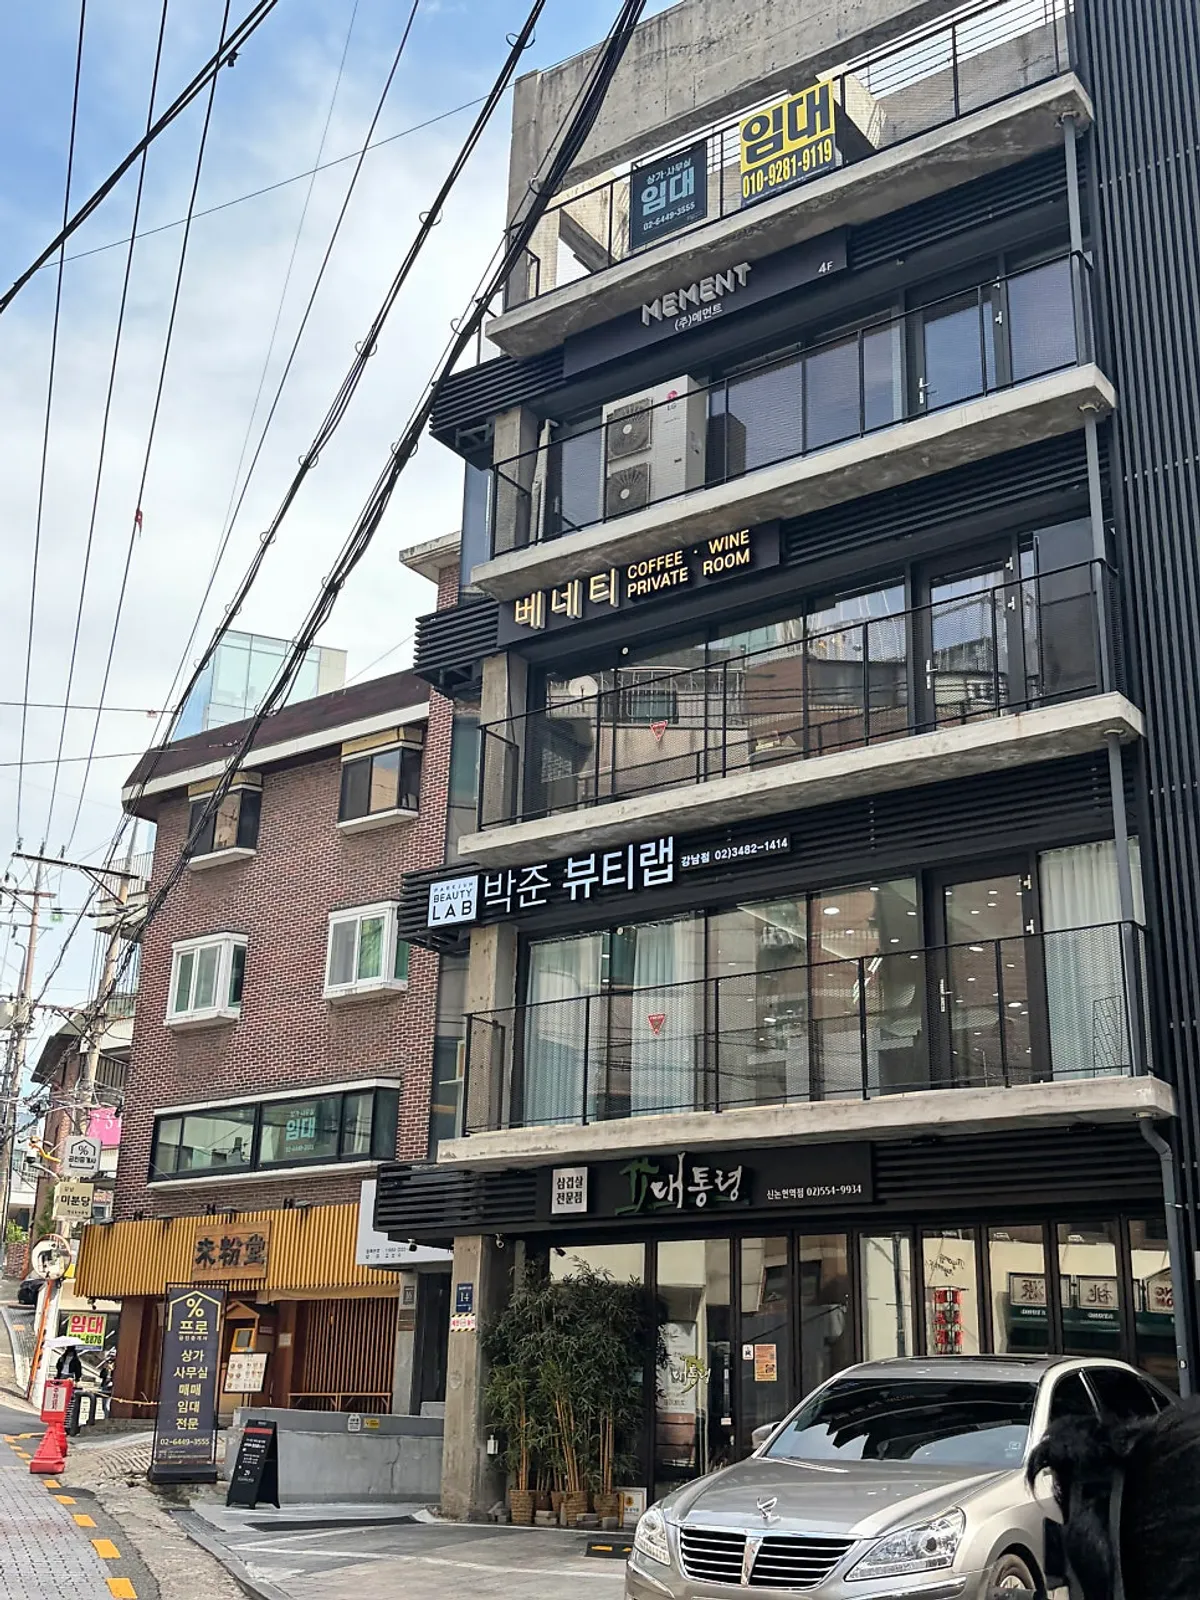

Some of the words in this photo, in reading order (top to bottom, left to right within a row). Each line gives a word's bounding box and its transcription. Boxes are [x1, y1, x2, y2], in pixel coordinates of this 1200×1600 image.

[742, 84, 831, 164] 임대
[742, 138, 833, 198] 010-9281-9119
[641, 166, 695, 216] 임대
[818, 261, 834, 274] 4F
[641, 262, 752, 326] MEMENT
[627, 550, 684, 580] COFFEE
[708, 530, 751, 555] WINE
[626, 567, 689, 598] PRIVATE
[703, 548, 751, 576] ROOM
[513, 567, 620, 630] 베네티
[680, 851, 710, 867] 강남점
[714, 837, 788, 860] 02)3482-1414
[483, 863, 552, 914] 박준
[562, 835, 675, 901] 뷰티랩
[433, 889, 473, 903] BEAUTY
[432, 900, 472, 921] LAB
[285, 1116, 316, 1141] 임대
[556, 1175, 583, 1190] 삼겹살
[650, 1152, 743, 1209] 대통령
[61, 1195, 91, 1208] 미분당
[556, 1191, 583, 1205] 전문점
[766, 1187, 804, 1200] 신논현역점
[806, 1184, 862, 1197] 02)554-9934
[71, 1315, 104, 1334] 임대
[179, 1320, 209, 1335] 프로
[181, 1349, 204, 1362] 상가
[173, 1366, 208, 1379] 사무실
[178, 1383, 202, 1396] 매매
[177, 1400, 200, 1413] 임대
[175, 1418, 199, 1430] 전문
